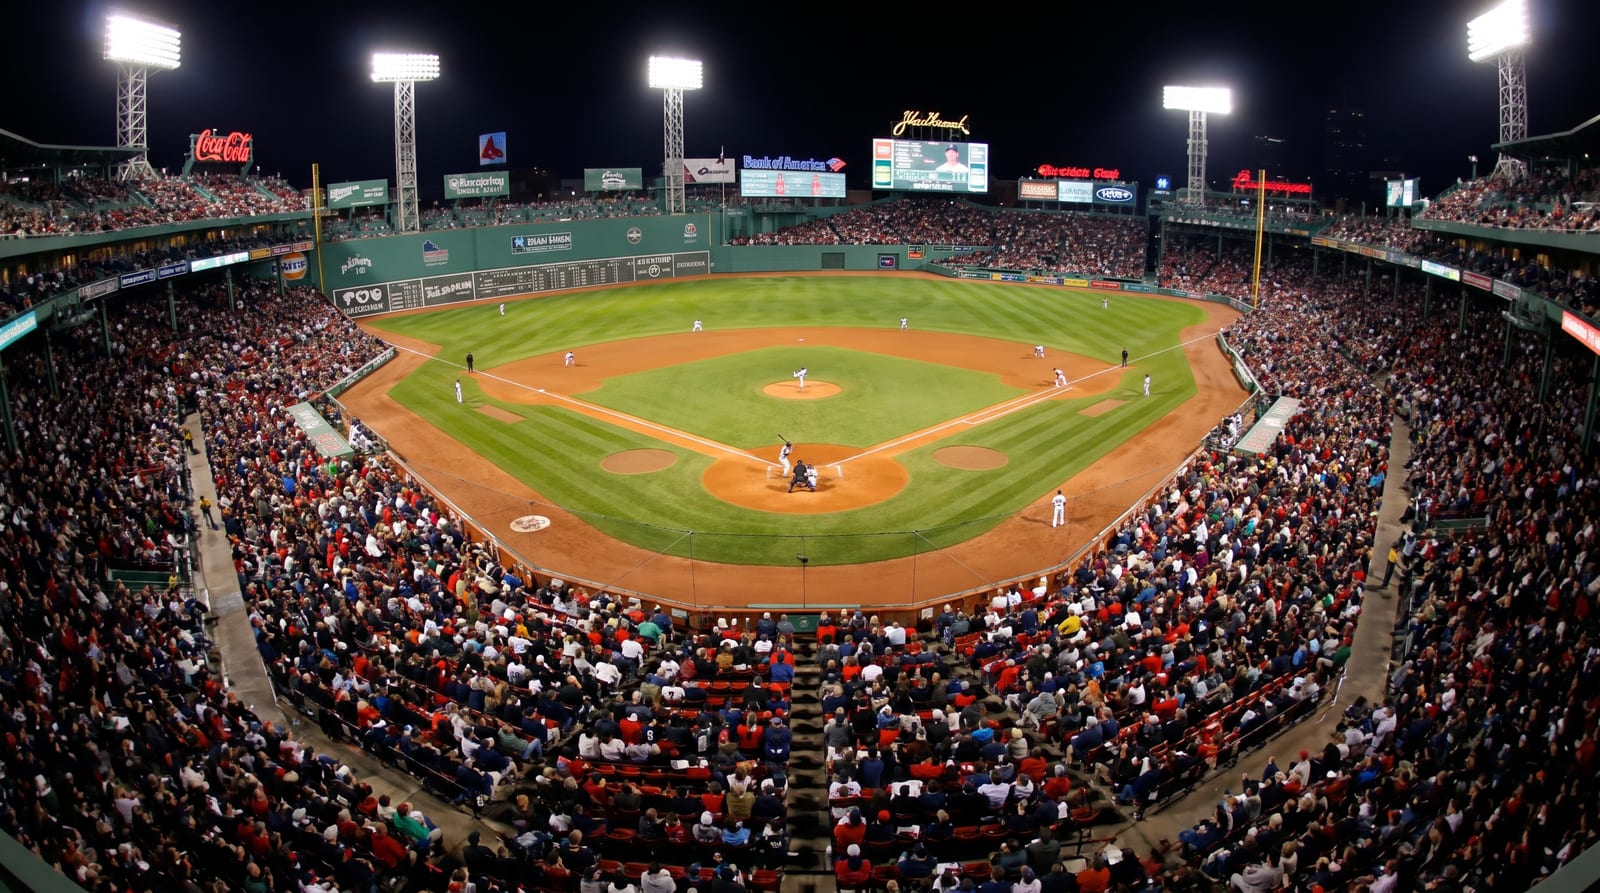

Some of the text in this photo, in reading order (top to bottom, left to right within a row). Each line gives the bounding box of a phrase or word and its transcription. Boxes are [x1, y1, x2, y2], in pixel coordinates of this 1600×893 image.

[196, 129, 252, 162] Coca-Cola
[743, 155, 826, 171] Bank of America
